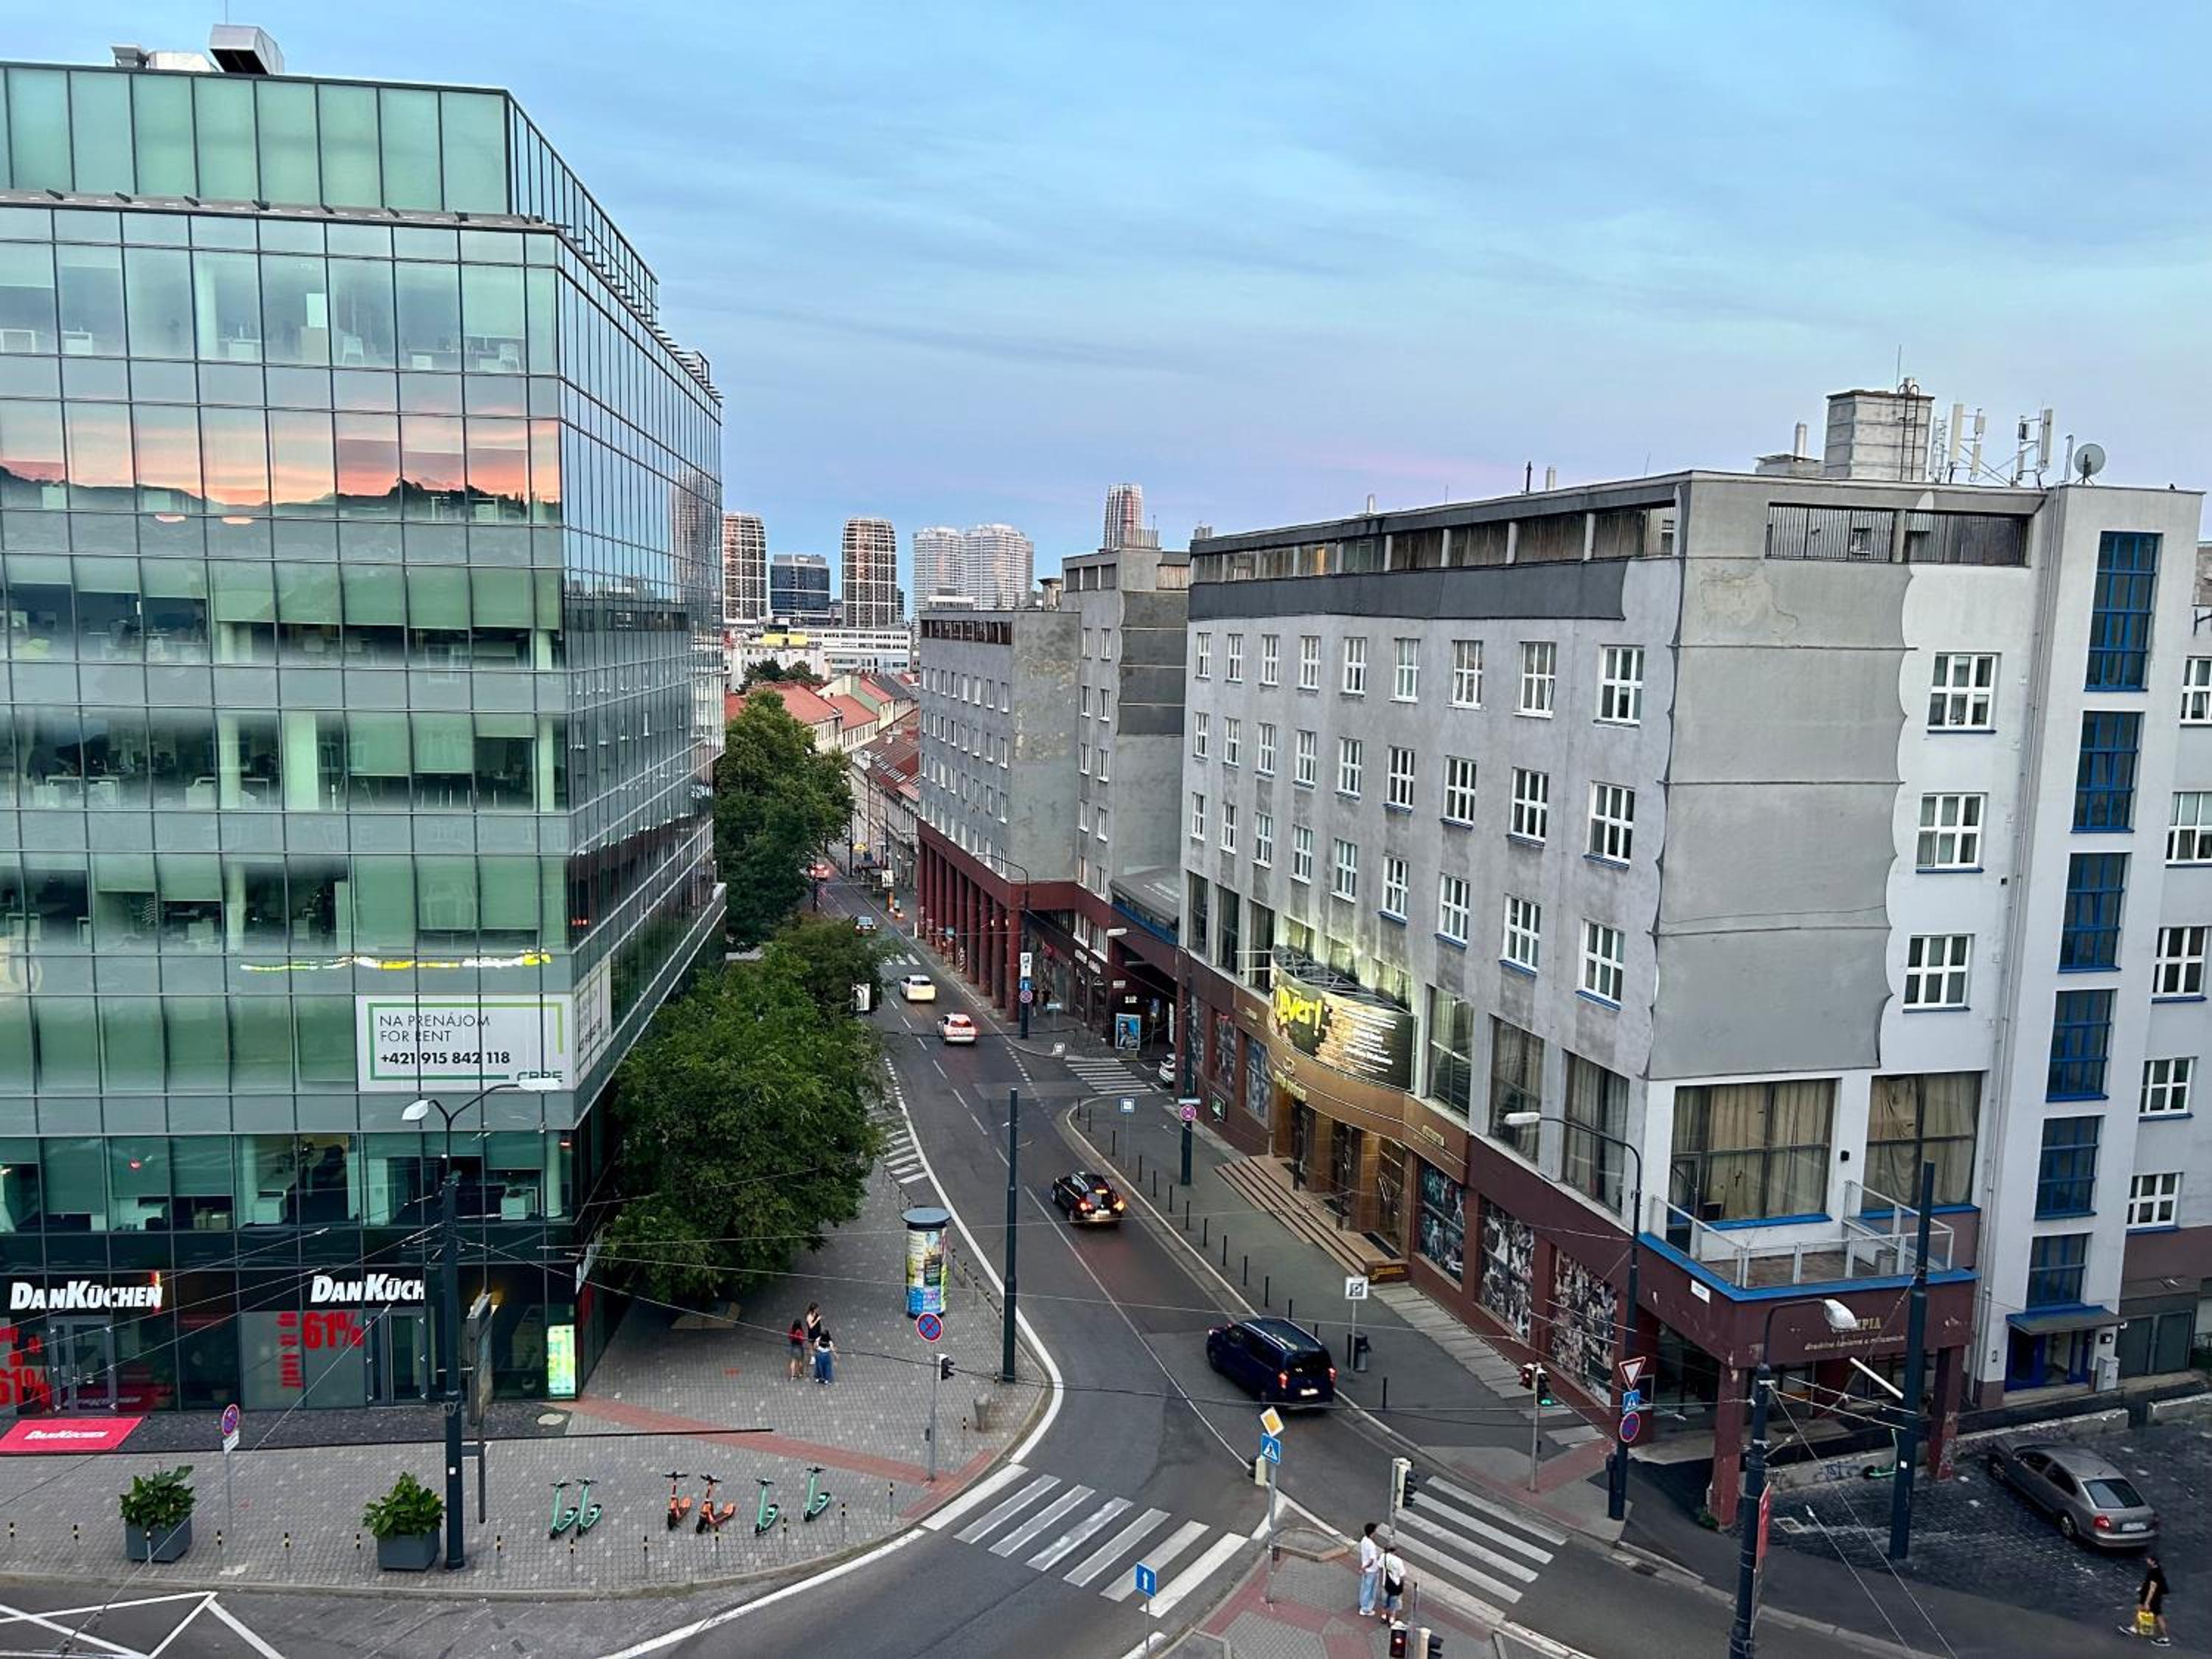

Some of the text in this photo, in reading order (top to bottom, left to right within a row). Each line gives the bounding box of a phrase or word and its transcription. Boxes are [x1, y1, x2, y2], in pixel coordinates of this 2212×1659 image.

[379, 1012, 490, 1027] NA PRENÁJOM
[380, 1030, 409, 1042] FOR
[380, 1051, 510, 1064] +421 915 842 118
[302, 1311, 365, 1350] 61%
